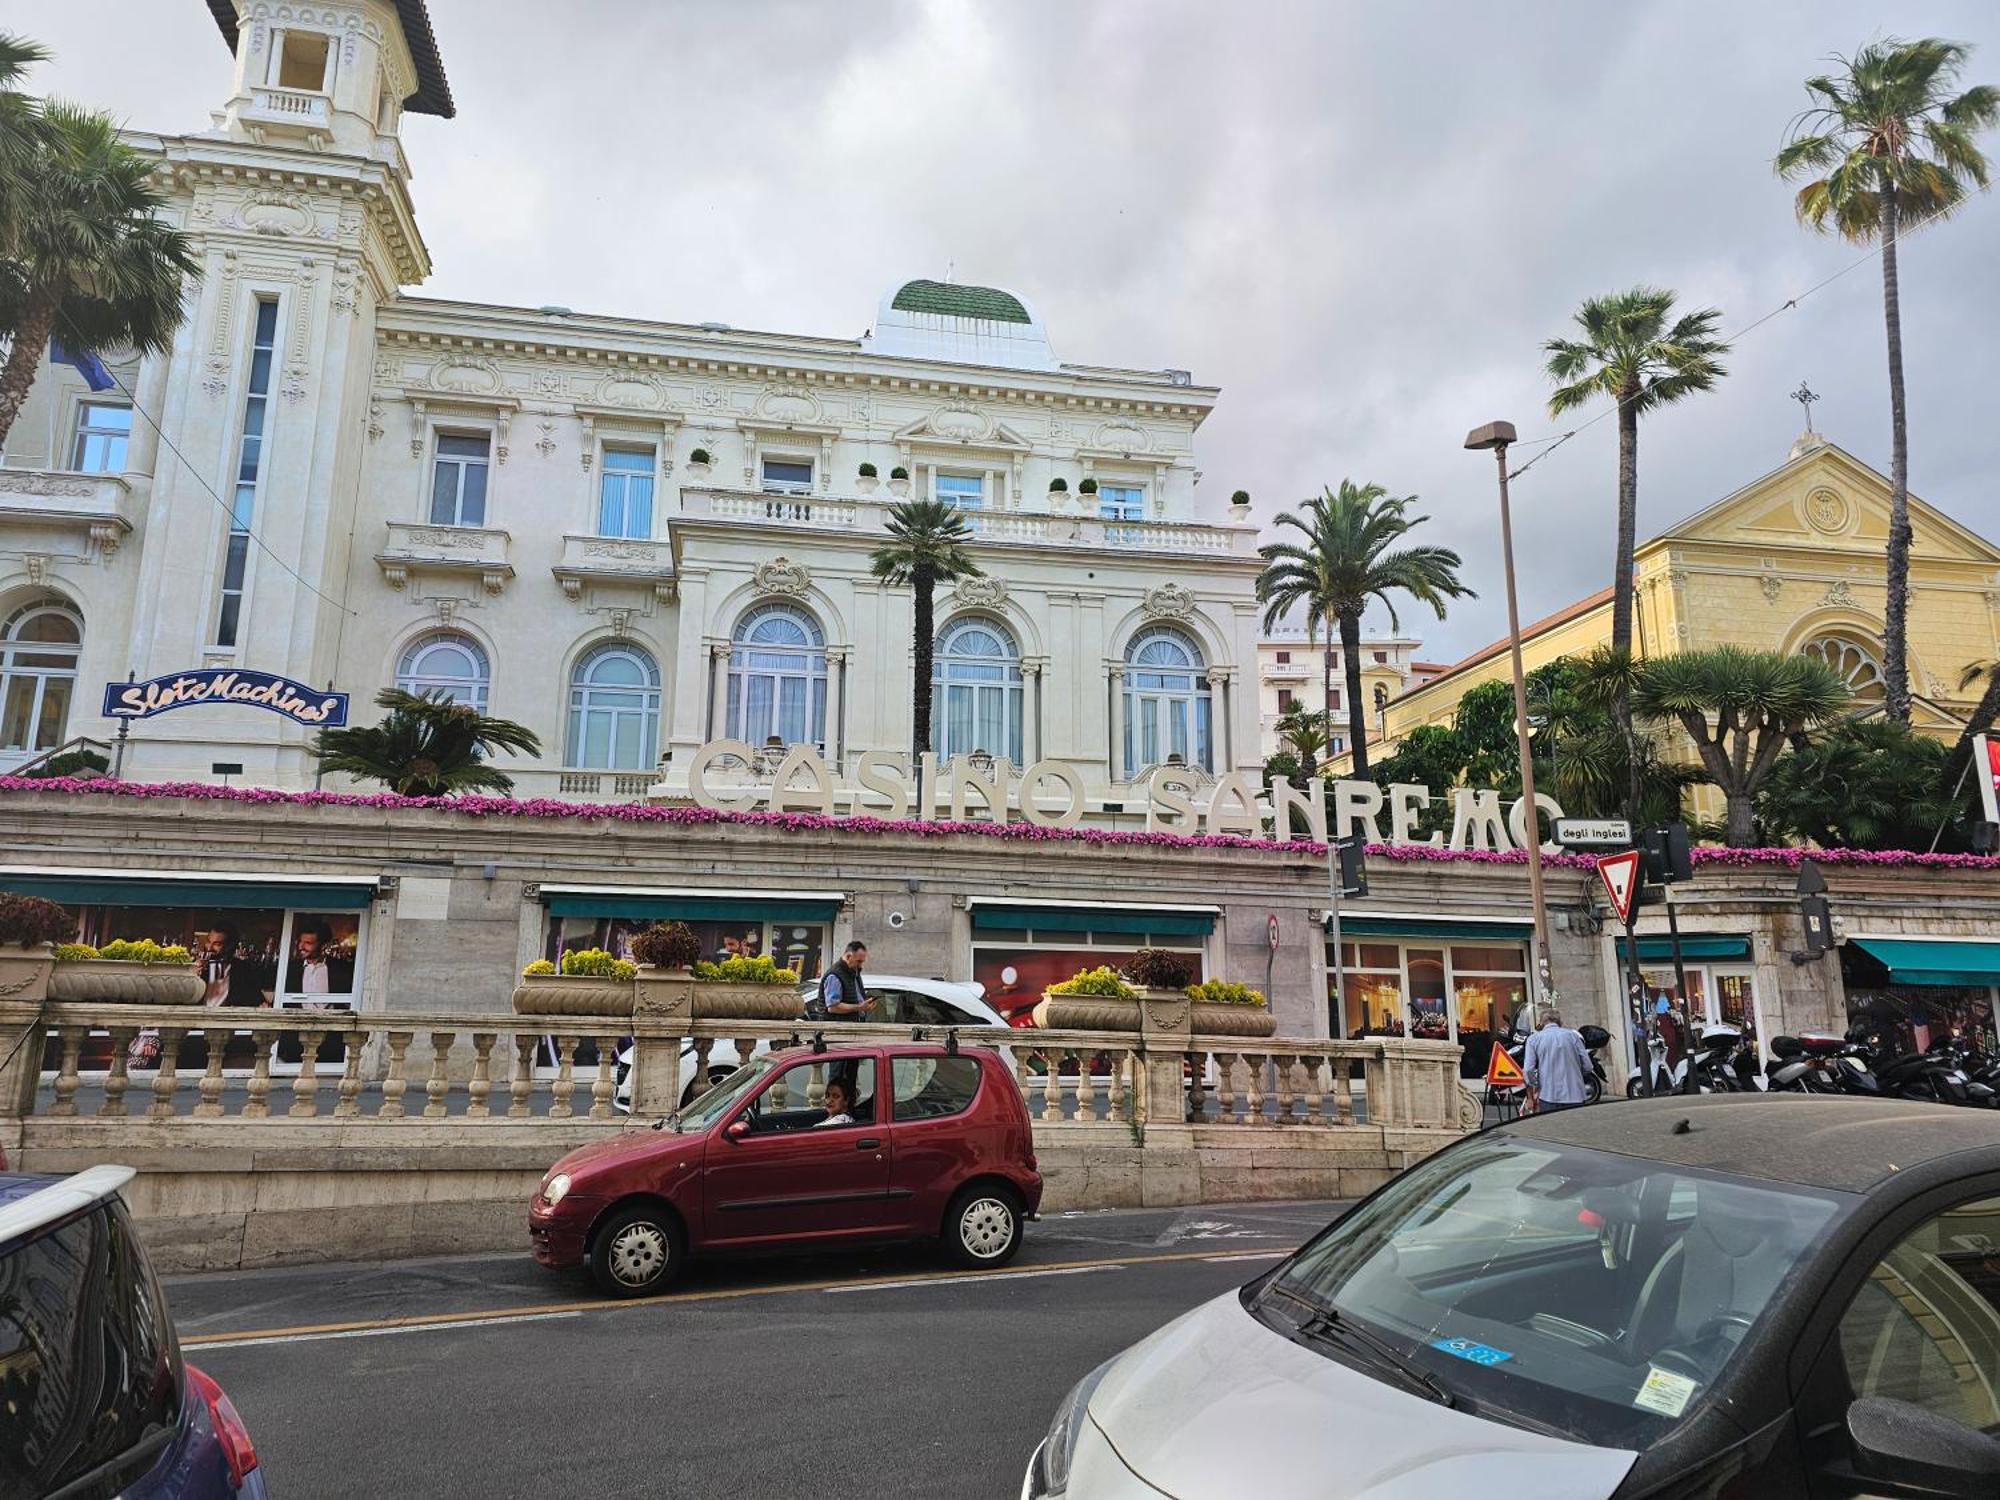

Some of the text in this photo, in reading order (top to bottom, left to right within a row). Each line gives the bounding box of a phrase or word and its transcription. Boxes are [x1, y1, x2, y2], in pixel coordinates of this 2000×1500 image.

[193, 672, 338, 722] Machines
[688, 738, 1566, 855] CASINO SANREMO
[1563, 828, 1626, 839] degli Inglesi
